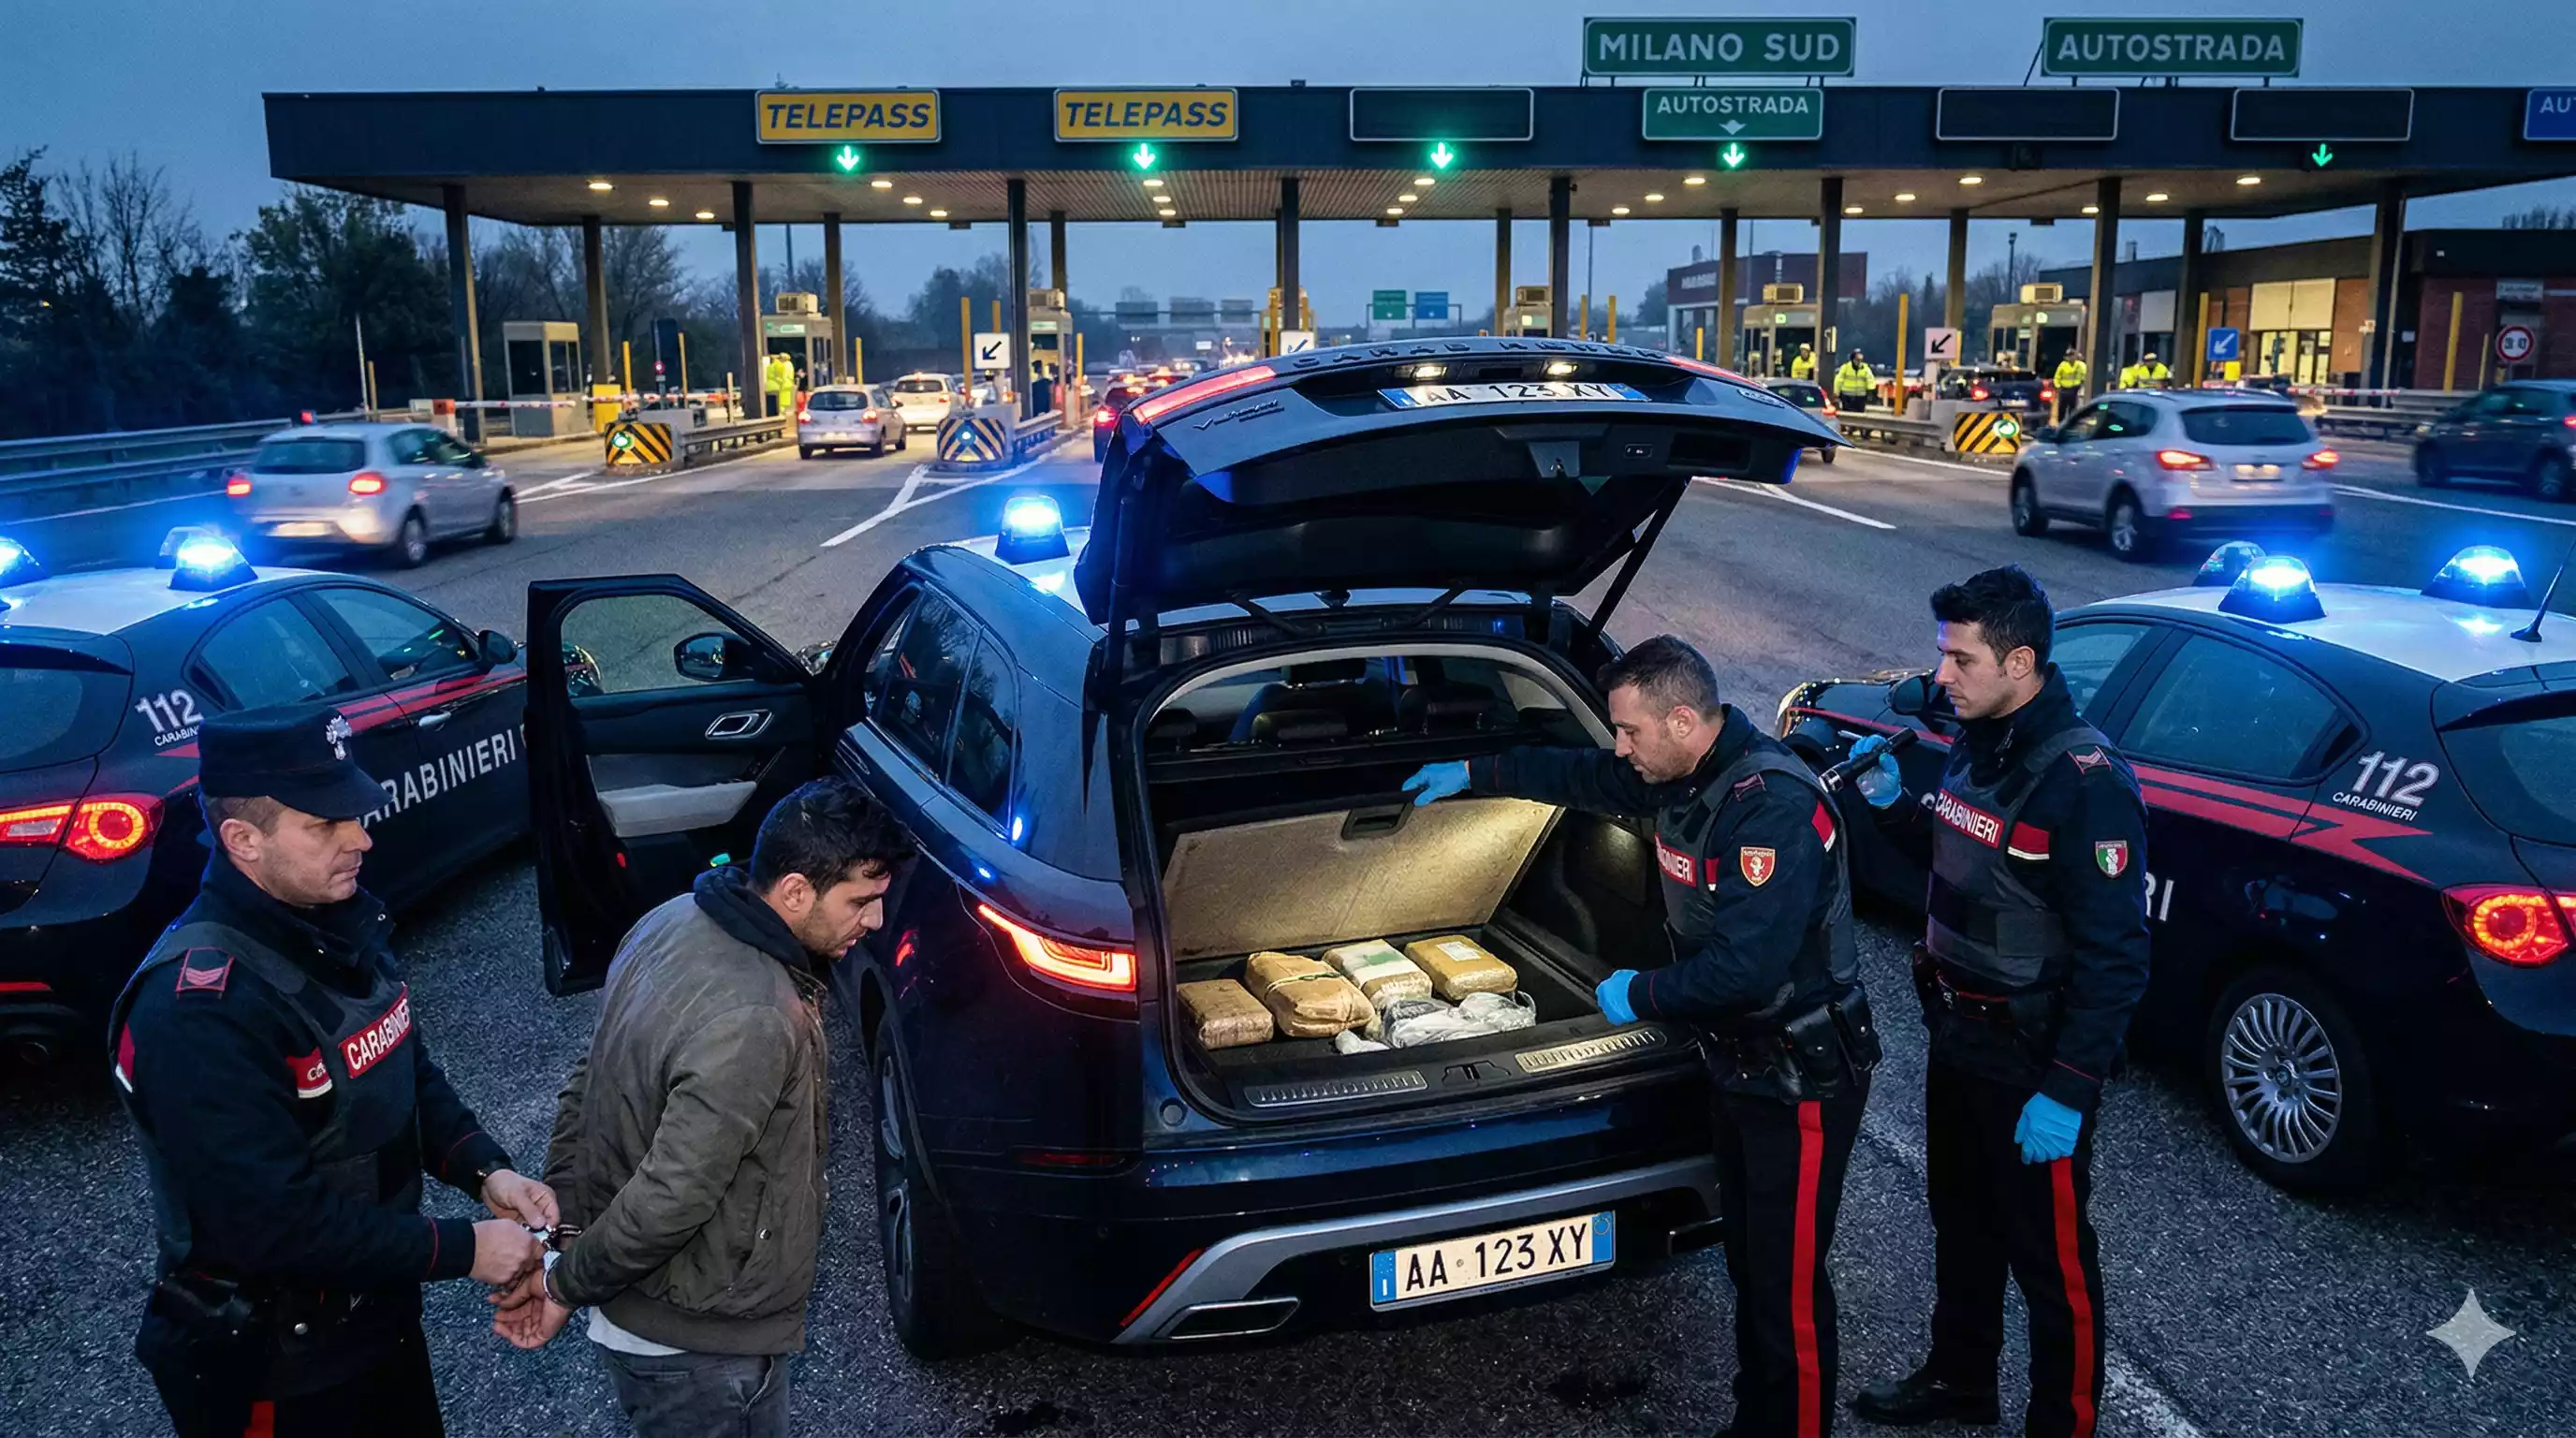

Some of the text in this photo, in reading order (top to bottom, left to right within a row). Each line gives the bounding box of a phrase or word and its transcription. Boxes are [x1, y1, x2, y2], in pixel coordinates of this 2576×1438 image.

[1599, 33, 1841, 62] MILANO SUD
[2056, 34, 2286, 62] AUTOSTRADA
[767, 103, 931, 129] TELEPASS
[1065, 101, 1228, 127] TELEPASS
[1657, 95, 1809, 114] AUTOSTRADA
[2539, 95, 2576, 113] AU
[1426, 387, 1471, 402] AA
[1565, 383, 1611, 398] XY
[134, 689, 204, 733] 112
[2351, 750, 2440, 807] 112
[1935, 792, 1999, 844] CARABINIERI
[2333, 791, 2418, 821] CARABINIERI
[1405, 1250, 1449, 1292] AA
[1475, 1233, 1535, 1278] 123
[1547, 1223, 1588, 1265] XY
